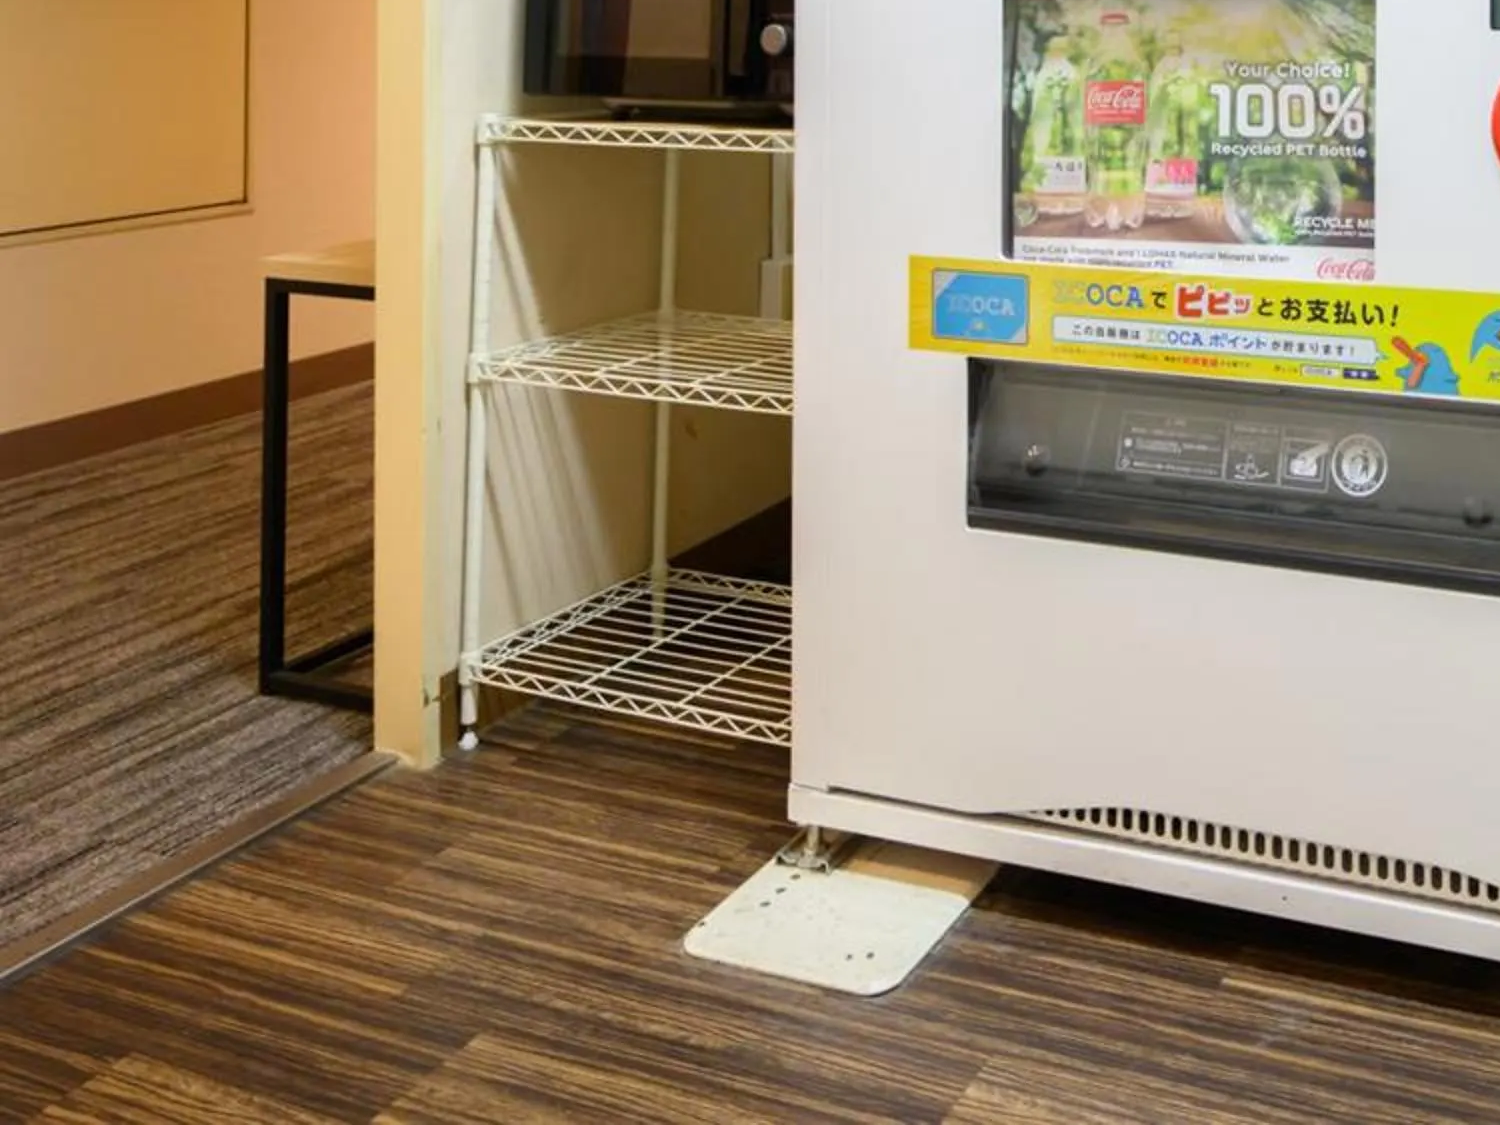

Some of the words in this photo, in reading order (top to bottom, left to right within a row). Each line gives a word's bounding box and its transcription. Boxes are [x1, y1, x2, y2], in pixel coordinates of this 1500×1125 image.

[1226, 62, 1272, 79] Your
[1276, 61, 1351, 79] Choice!
[1209, 82, 1366, 140] 100%
[1211, 141, 1282, 158] Recycled
[1285, 143, 1315, 158] PET
[1319, 143, 1367, 159] Bottle
